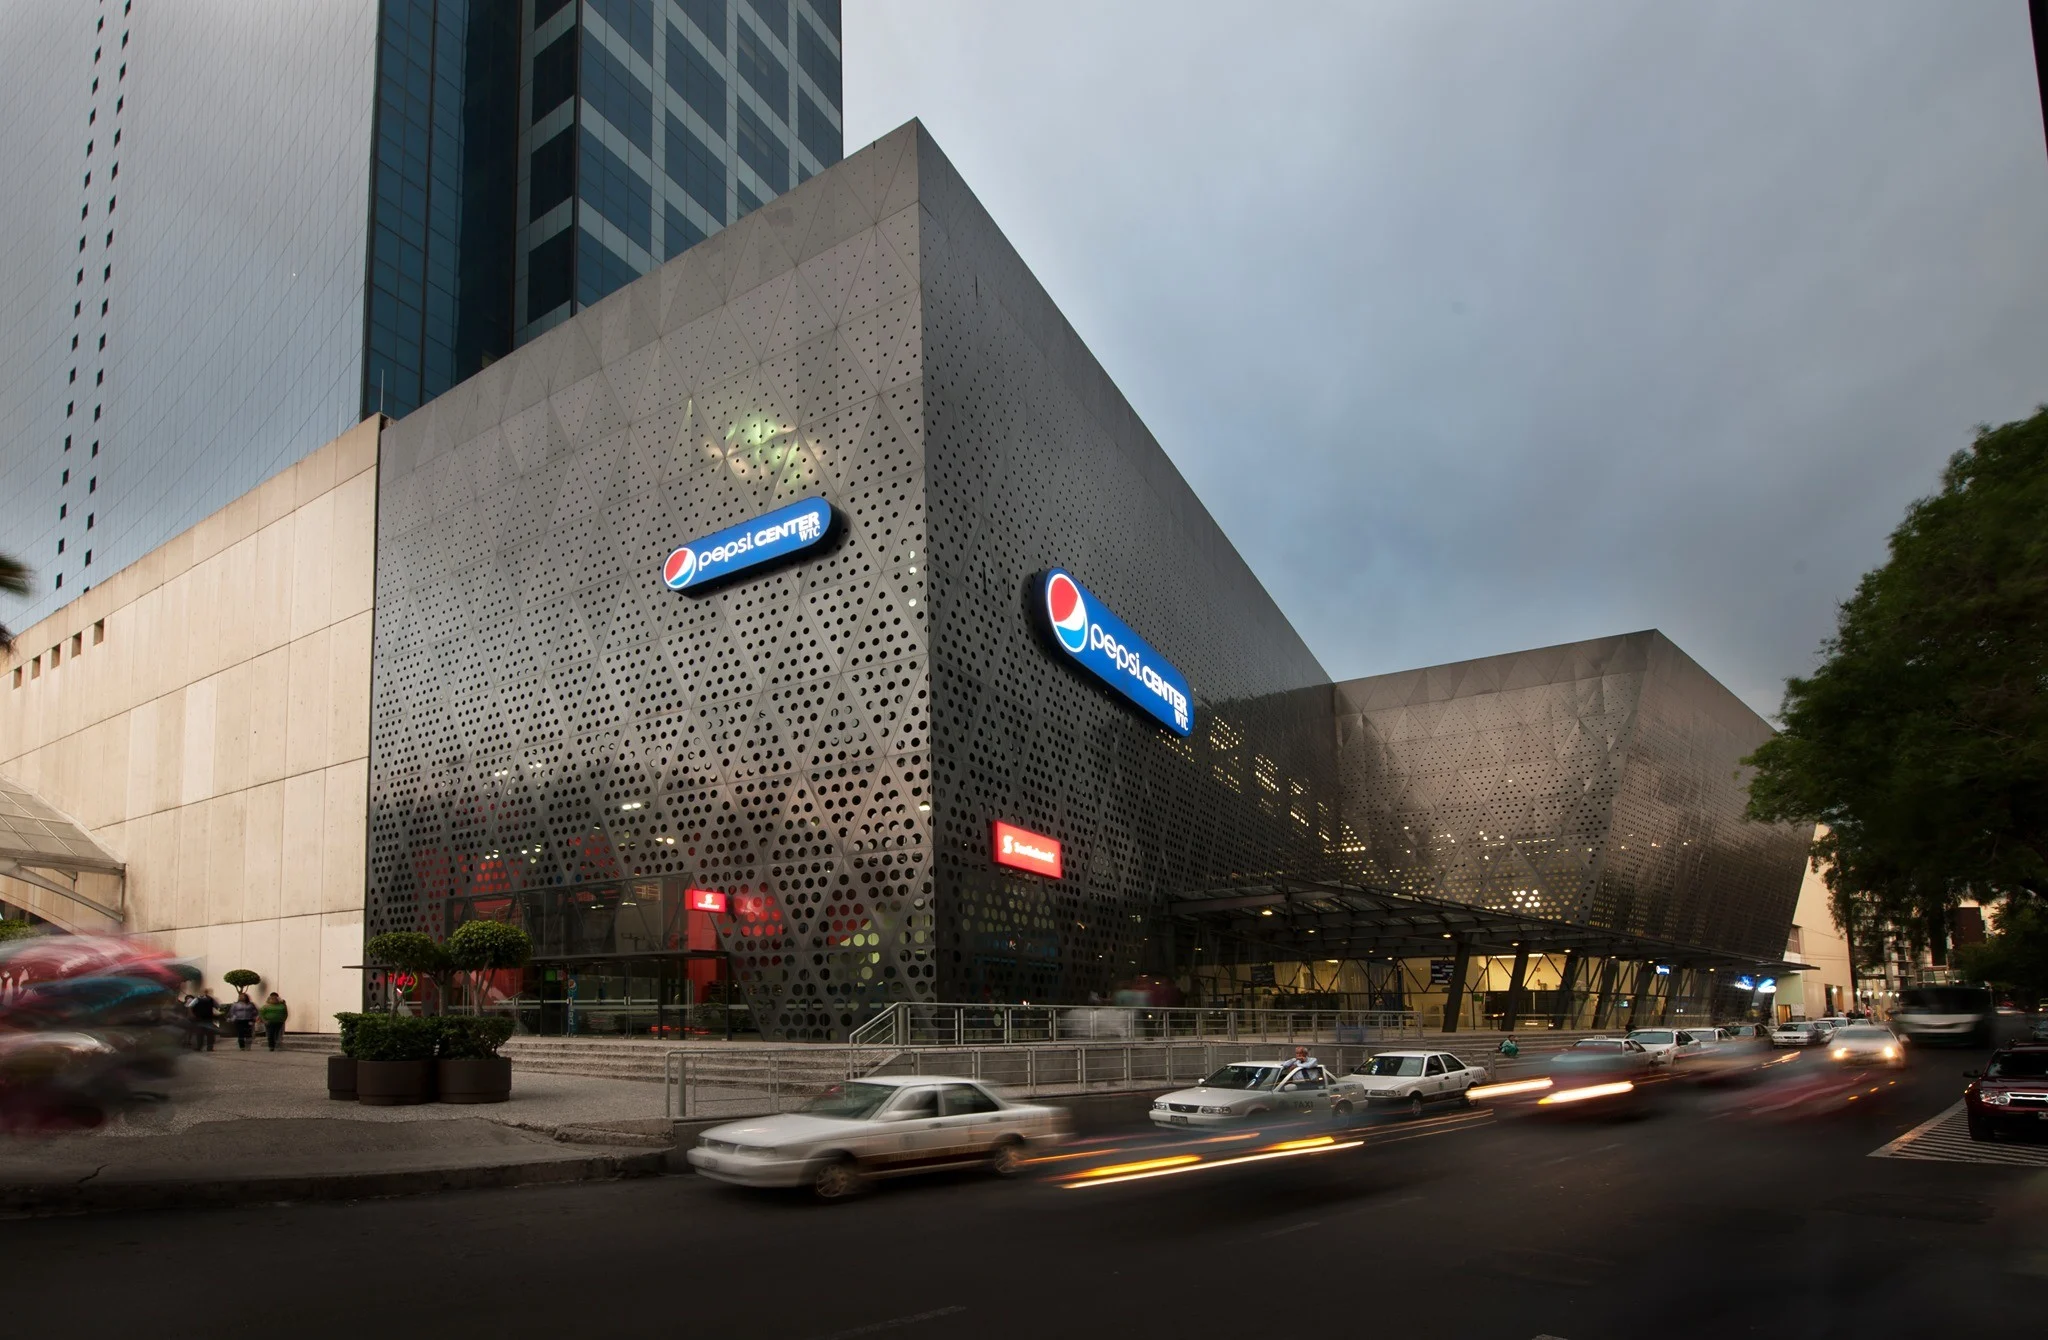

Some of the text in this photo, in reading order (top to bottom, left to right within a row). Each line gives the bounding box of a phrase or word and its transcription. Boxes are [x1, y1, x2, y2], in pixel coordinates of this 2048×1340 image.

[699, 511, 820, 571] pepsi CENTER
[799, 525, 821, 542] WTC
[1090, 623, 1188, 717] pepsi CENTER
[1174, 708, 1189, 731] WTC
[1294, 1100, 1314, 1108] TAXI
